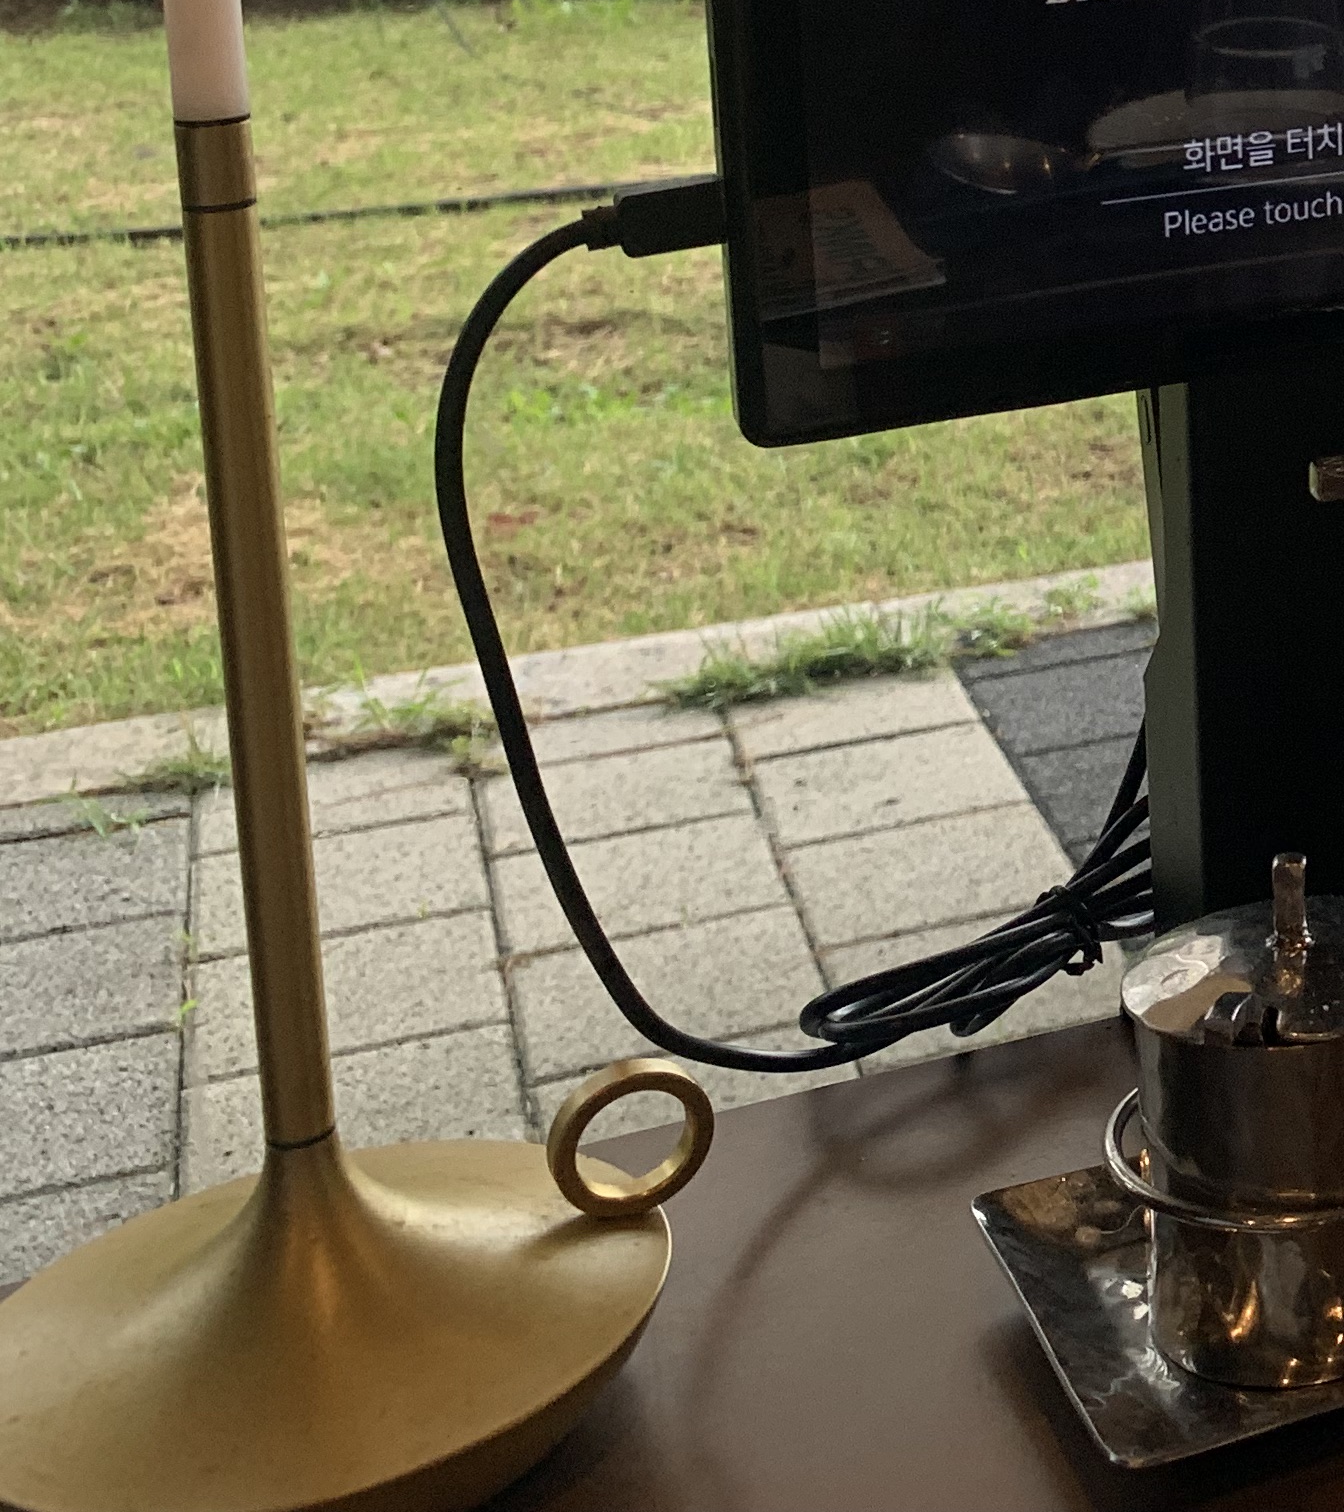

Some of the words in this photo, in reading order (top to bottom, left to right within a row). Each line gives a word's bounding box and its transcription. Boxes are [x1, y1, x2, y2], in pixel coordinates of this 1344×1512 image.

[1182, 131, 1276, 173] 화면을
[1163, 205, 1256, 239] Please
[1263, 191, 1344, 226] touch
